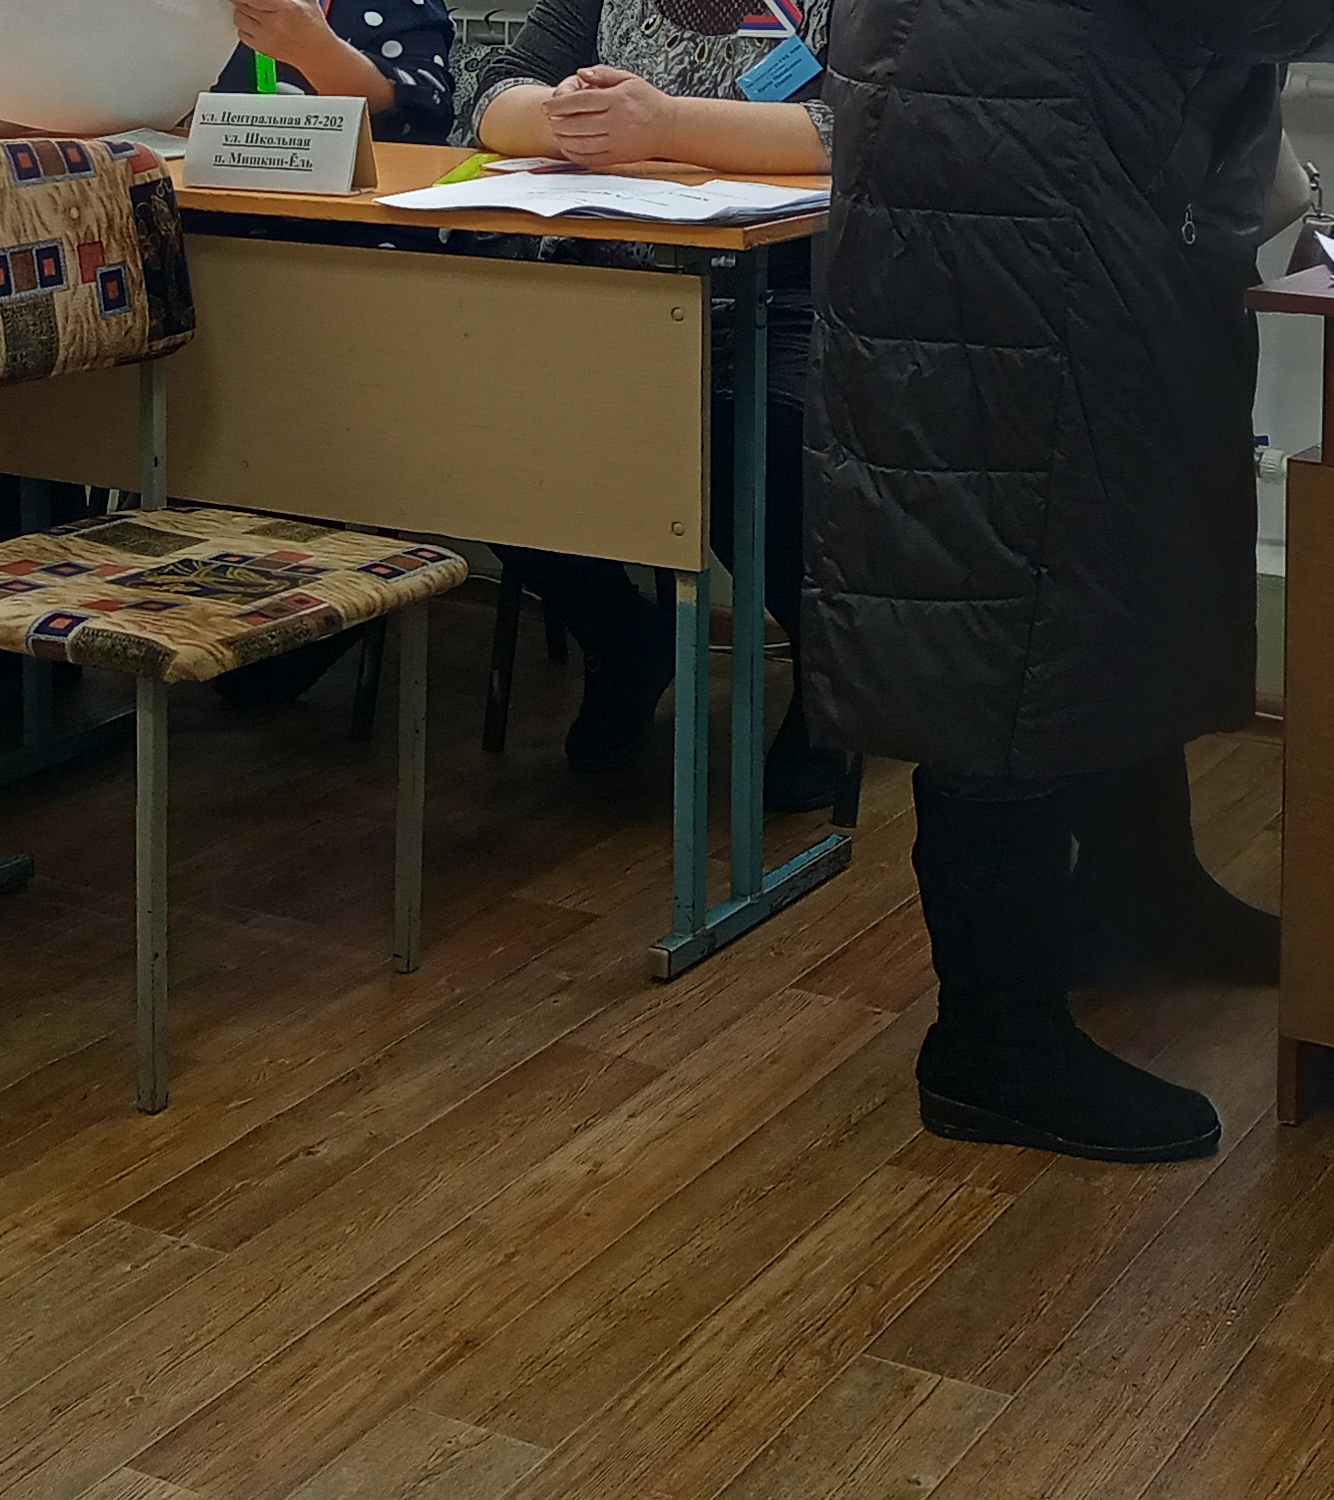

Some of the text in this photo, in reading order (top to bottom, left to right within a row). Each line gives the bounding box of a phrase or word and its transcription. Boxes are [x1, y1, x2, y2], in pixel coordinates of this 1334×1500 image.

[201, 110, 345, 129] ул. Центральная 87-202
[223, 132, 312, 148] ул. Школьная
[213, 152, 314, 169] п. Мишкин-Ёль
